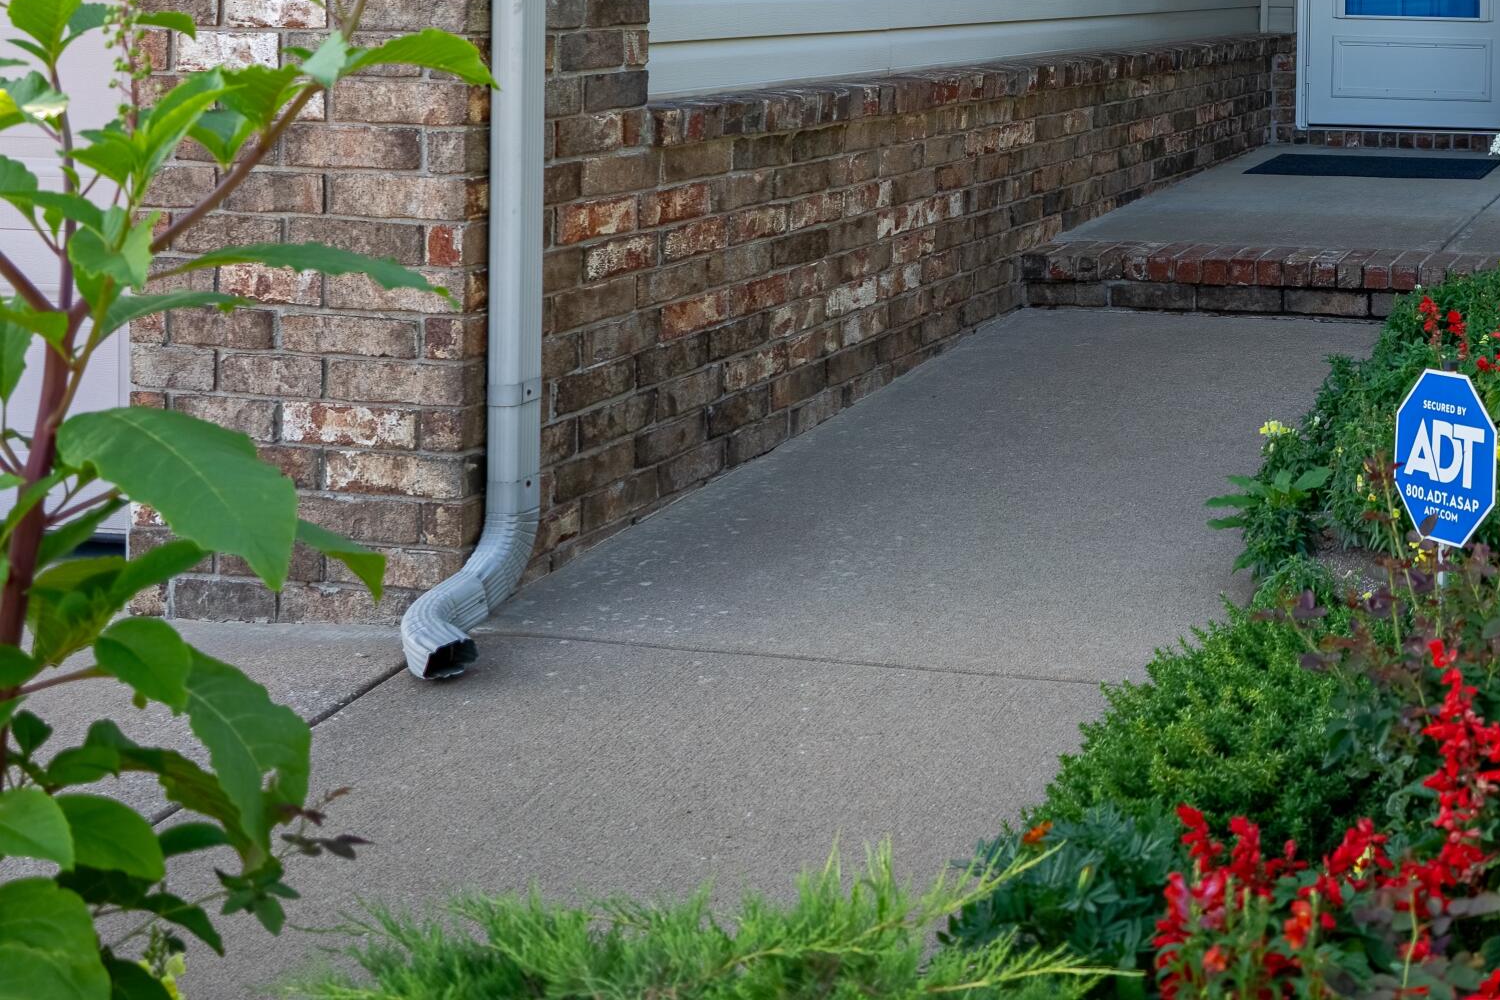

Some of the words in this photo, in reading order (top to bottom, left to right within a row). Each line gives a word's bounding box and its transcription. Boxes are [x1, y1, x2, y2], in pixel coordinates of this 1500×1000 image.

[1422, 399, 1455, 414] SECURED
[1456, 406, 1467, 416] BY
[1403, 417, 1485, 490] ADT
[1405, 483, 1480, 513] 800.ADT.ASAP
[1423, 505, 1459, 523] ADT.COM
